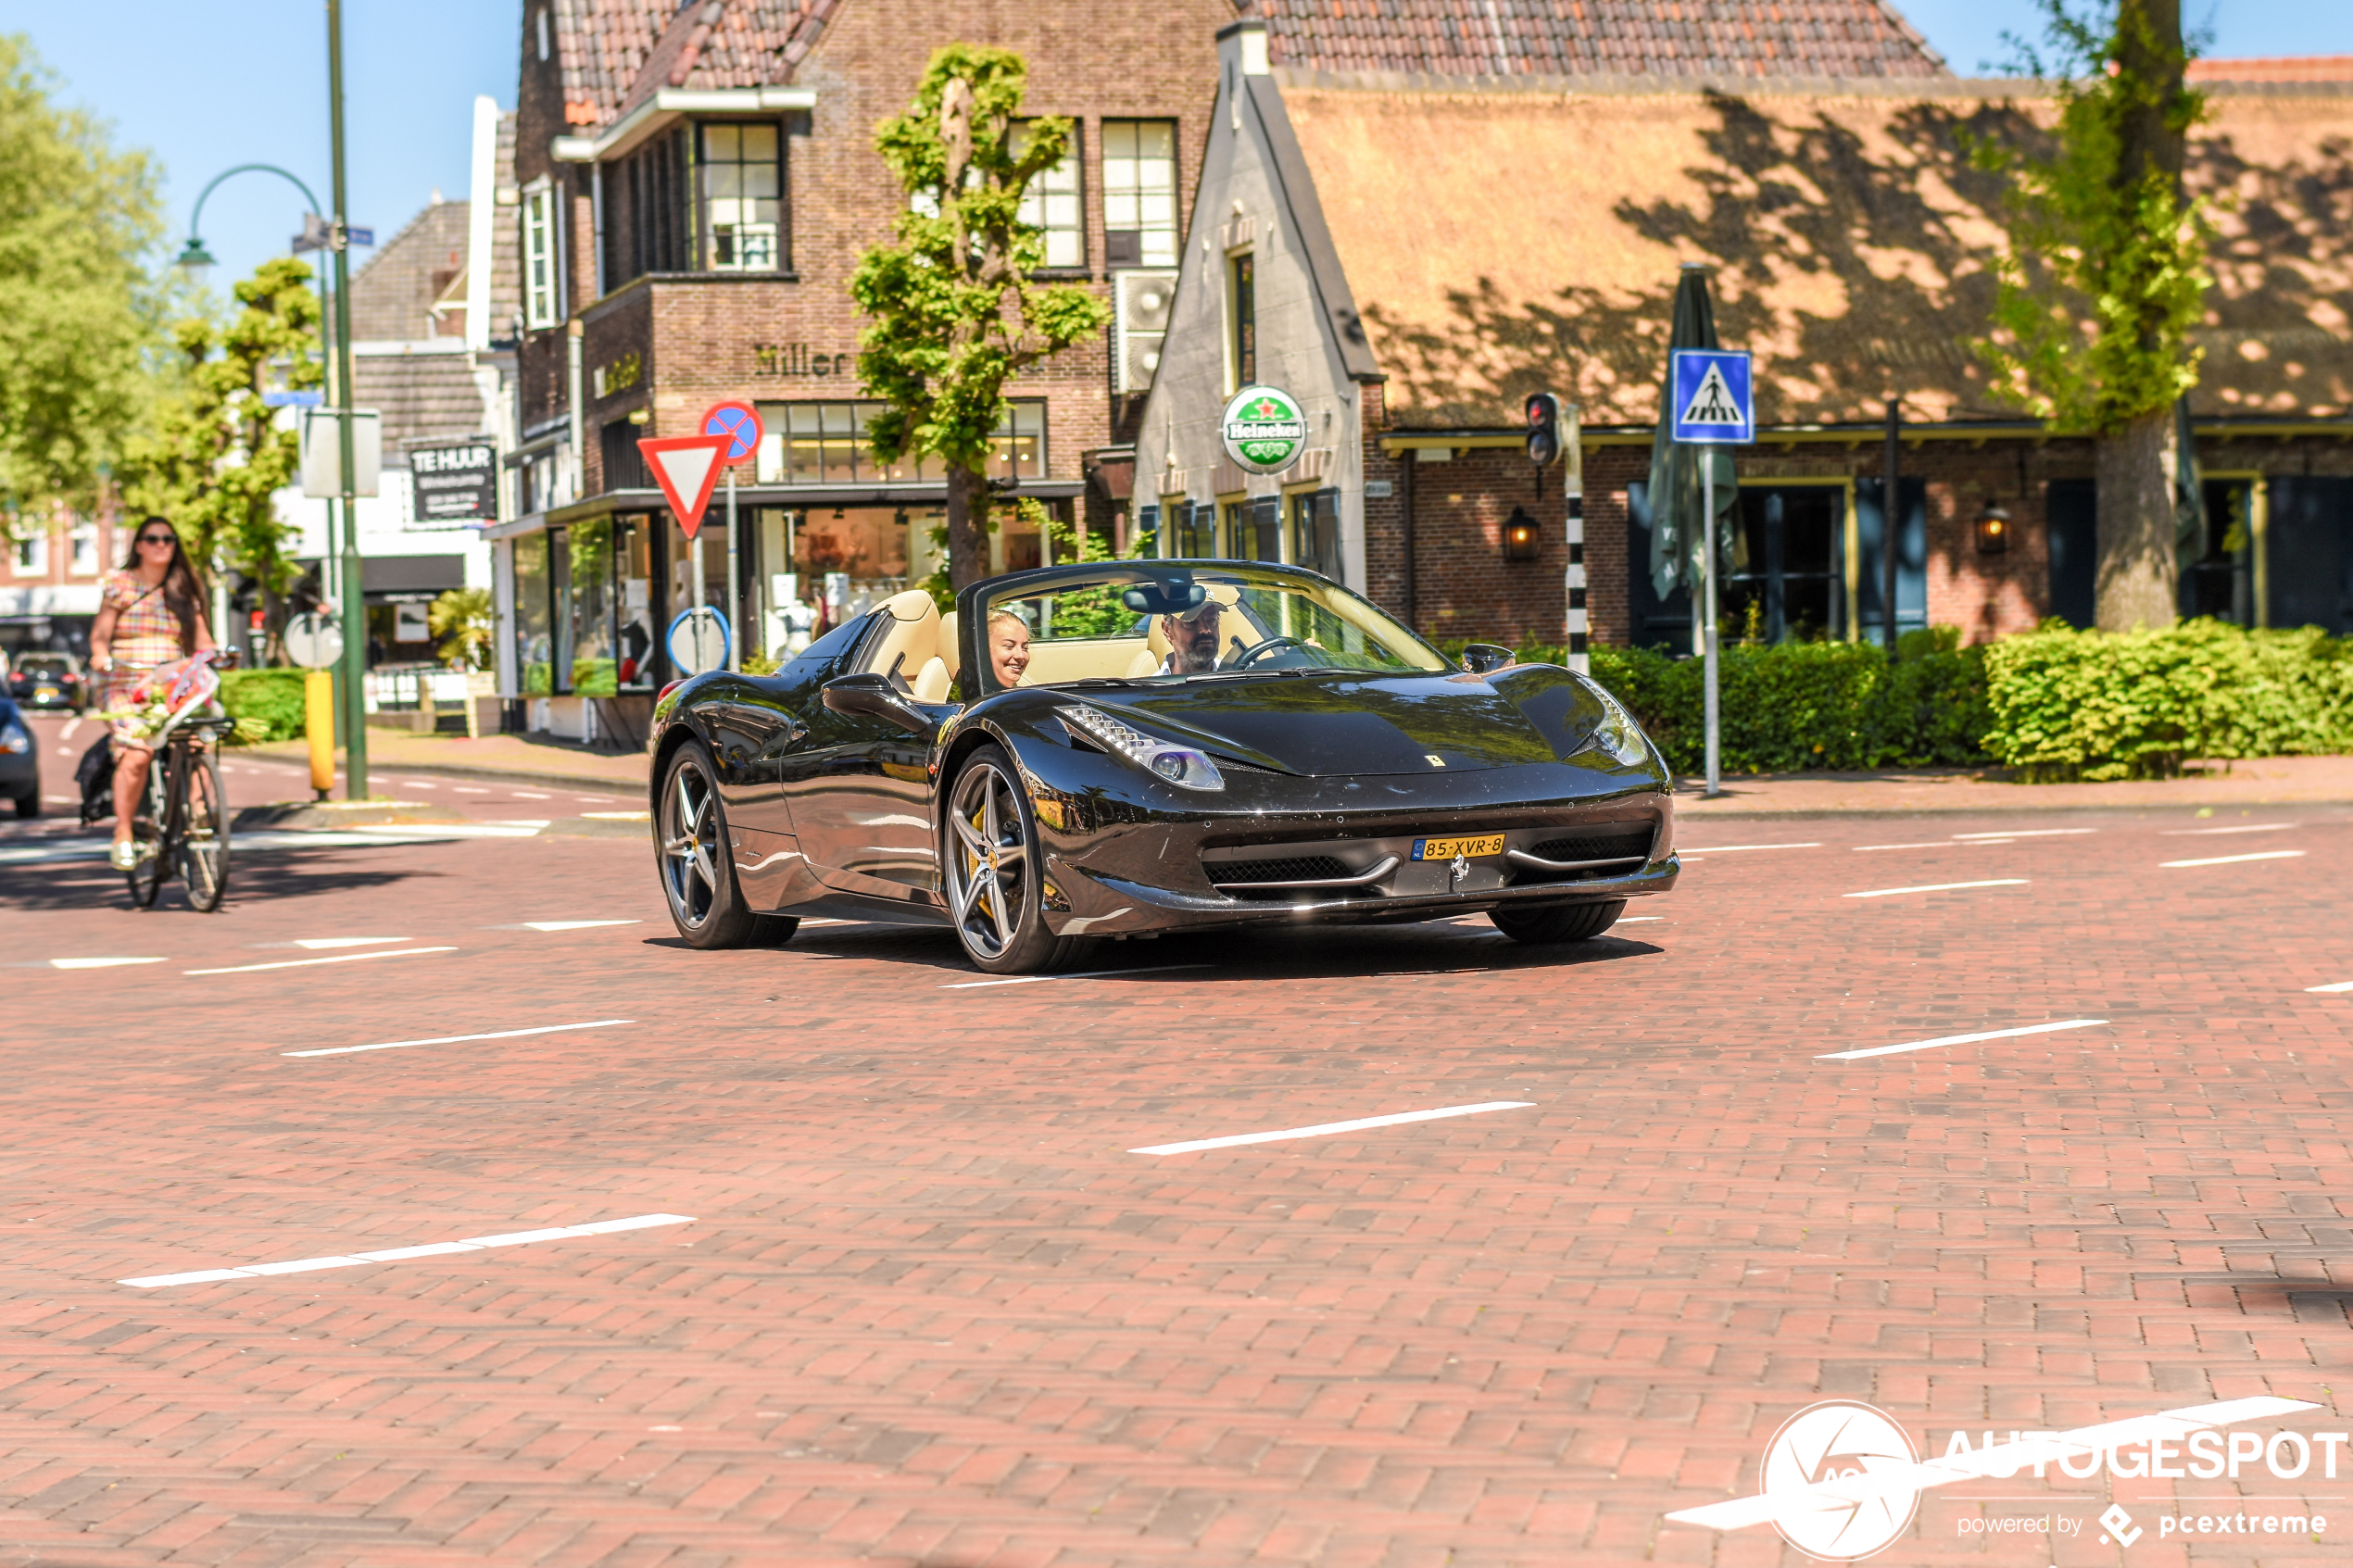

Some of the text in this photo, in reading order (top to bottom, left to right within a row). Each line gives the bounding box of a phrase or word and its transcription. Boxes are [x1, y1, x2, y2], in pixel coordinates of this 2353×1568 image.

[755, 343, 846, 376] Miller
[1229, 423, 1301, 439] Heineken
[410, 445, 490, 472] TE HUUR
[1426, 837, 1502, 857] 85-XVR-8
